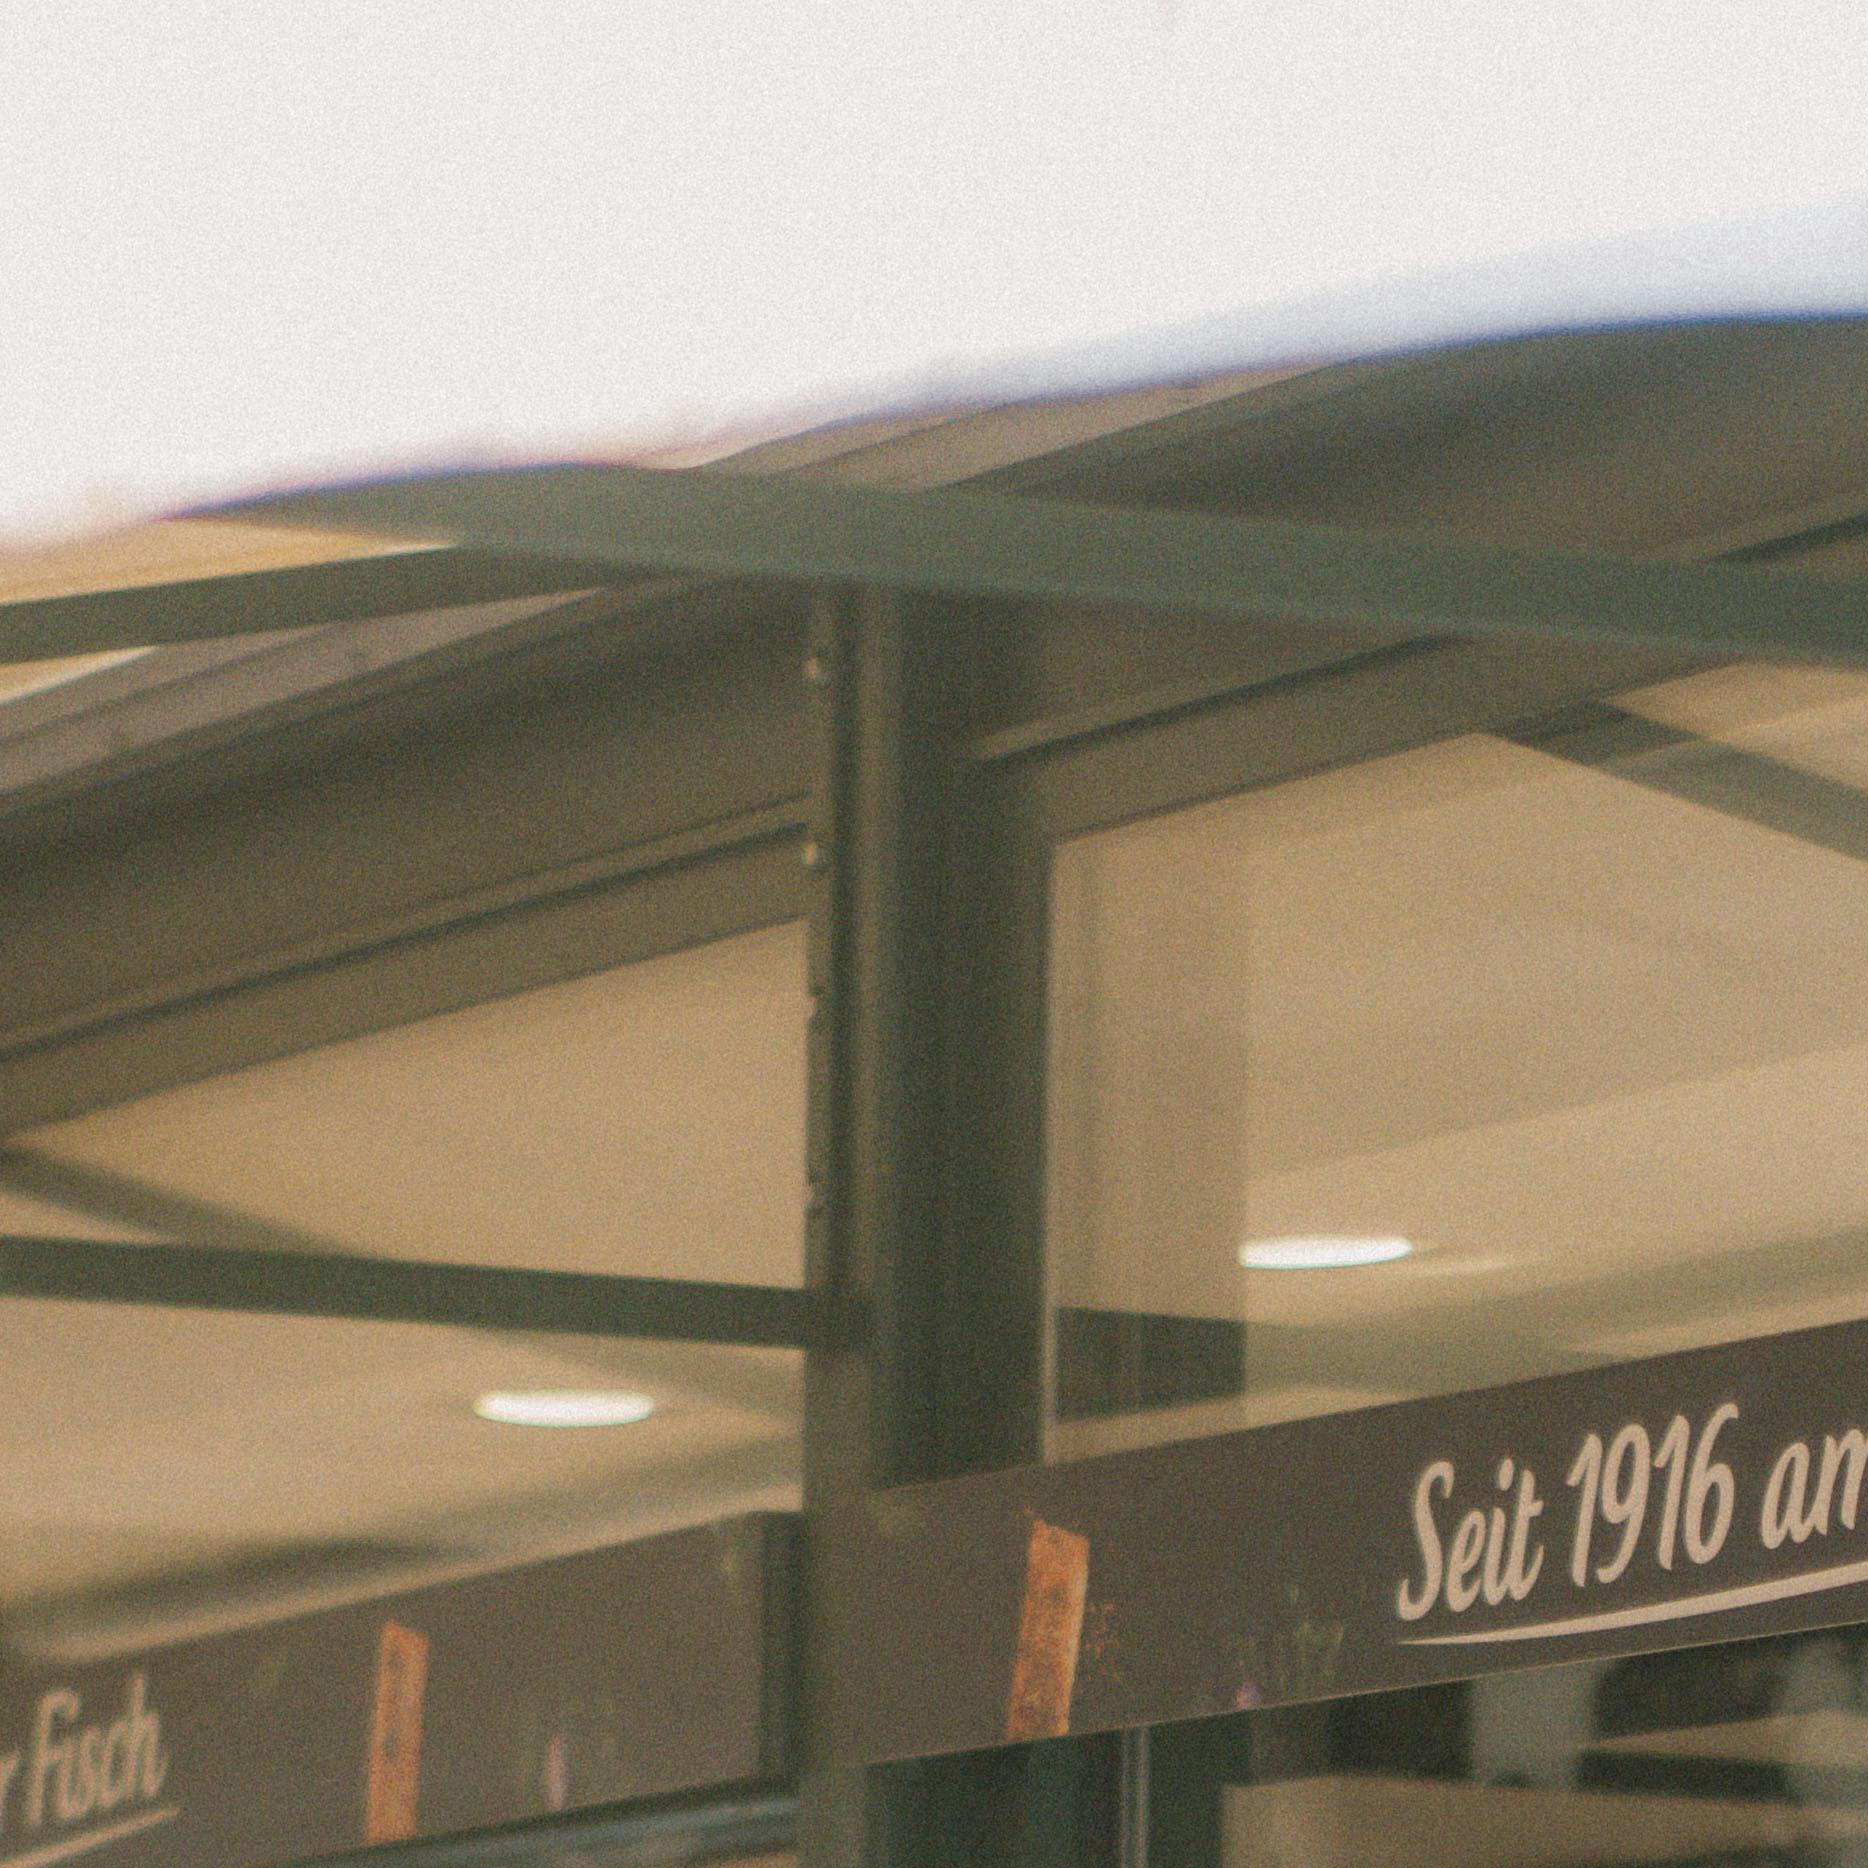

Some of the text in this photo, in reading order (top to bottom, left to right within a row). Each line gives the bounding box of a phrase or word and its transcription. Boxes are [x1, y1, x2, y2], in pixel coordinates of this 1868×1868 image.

[1399, 1457, 1546, 1621] Seit
[1566, 1403, 1740, 1588] 1916
[26, 1671, 170, 1827] Fisch
